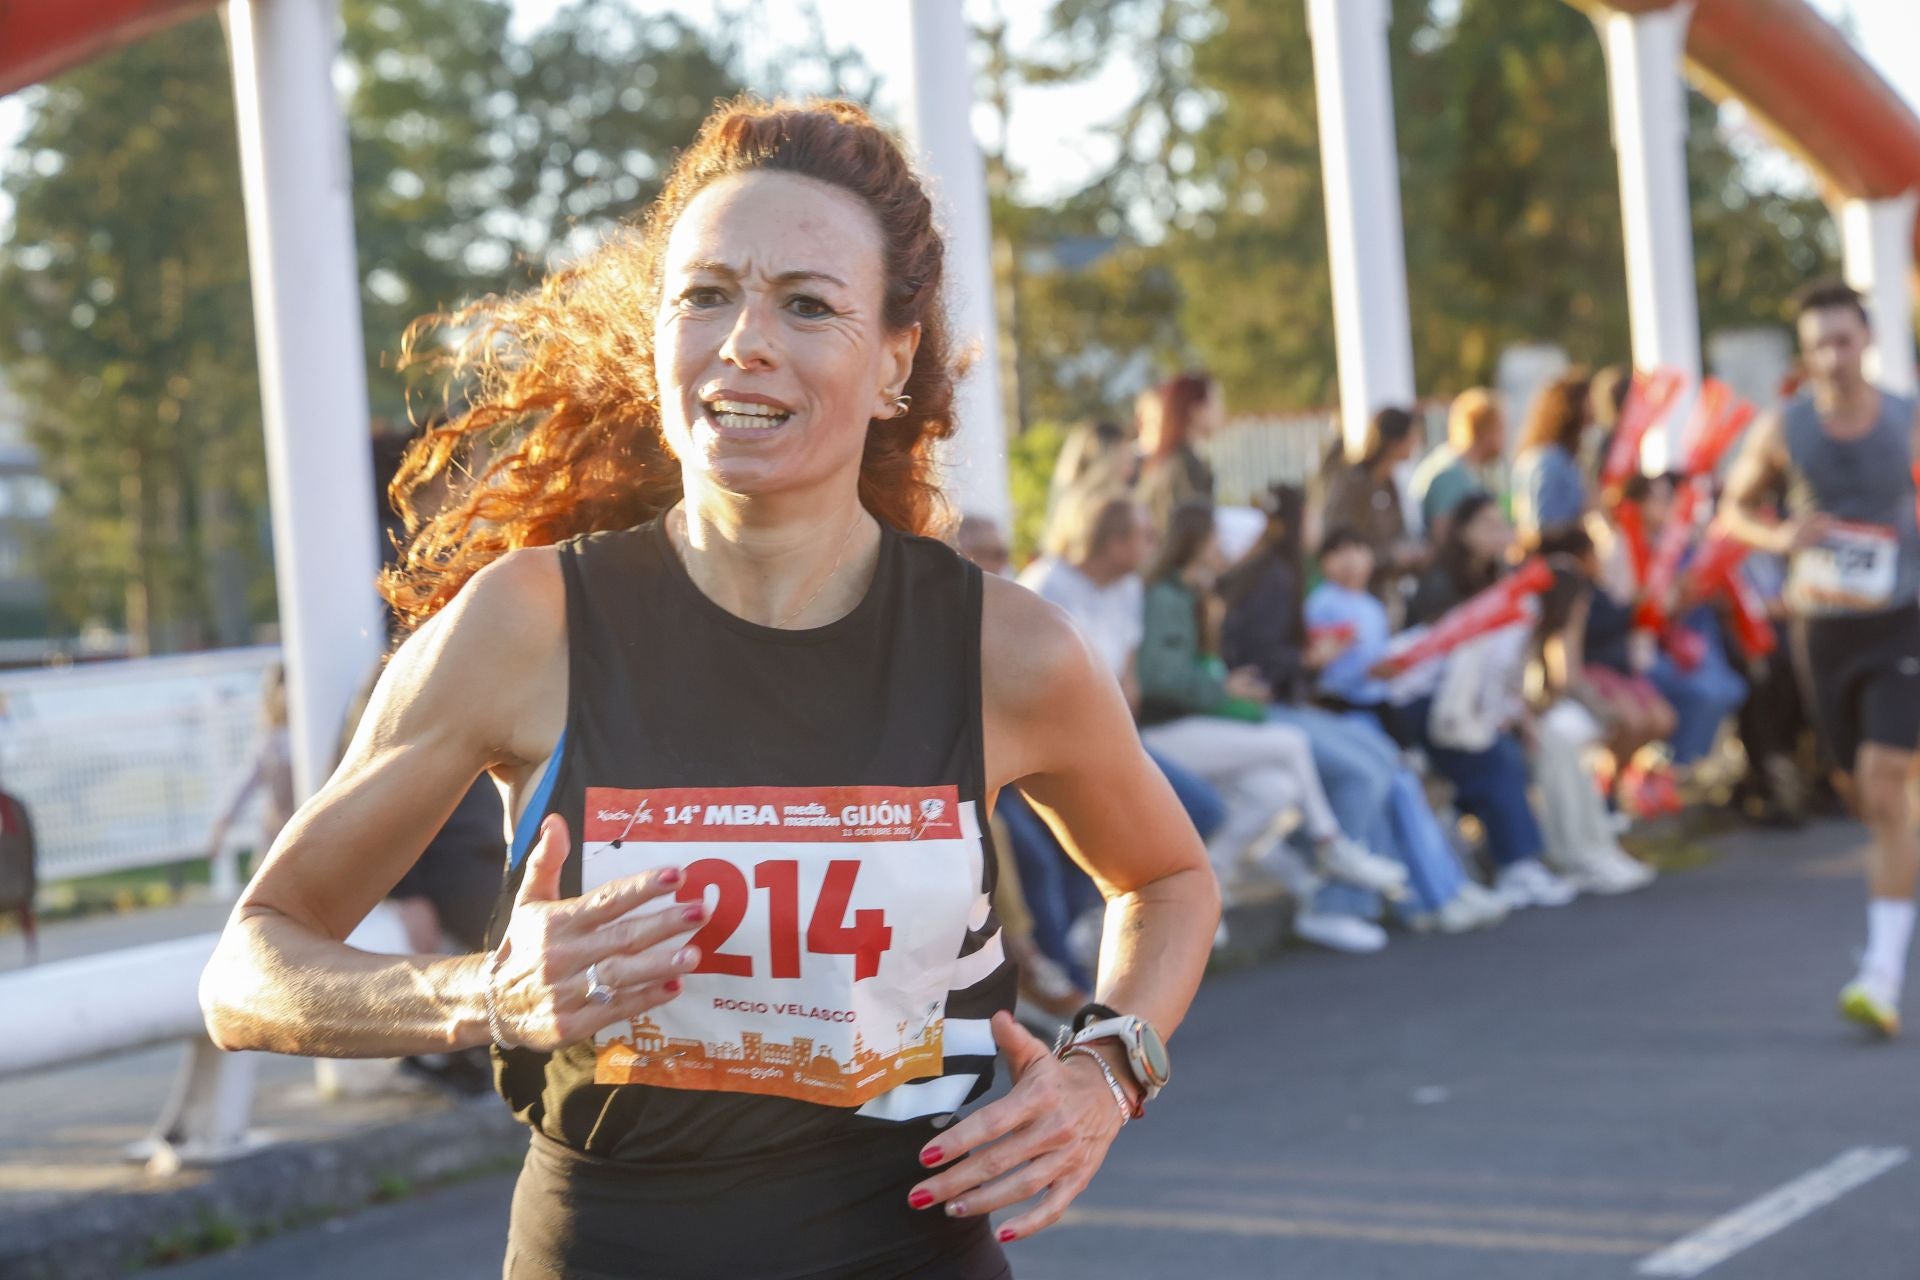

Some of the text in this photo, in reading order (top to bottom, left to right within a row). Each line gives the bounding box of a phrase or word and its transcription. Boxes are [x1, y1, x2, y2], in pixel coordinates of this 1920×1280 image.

[703, 805, 780, 826] MBA
[783, 803, 827, 816] media
[841, 800, 912, 826] GIJÓN
[783, 814, 841, 827] maratón
[854, 827, 892, 837] OCTUBRE
[675, 858, 892, 982] 214
[713, 998, 857, 1023] ROCIO VELASCO
